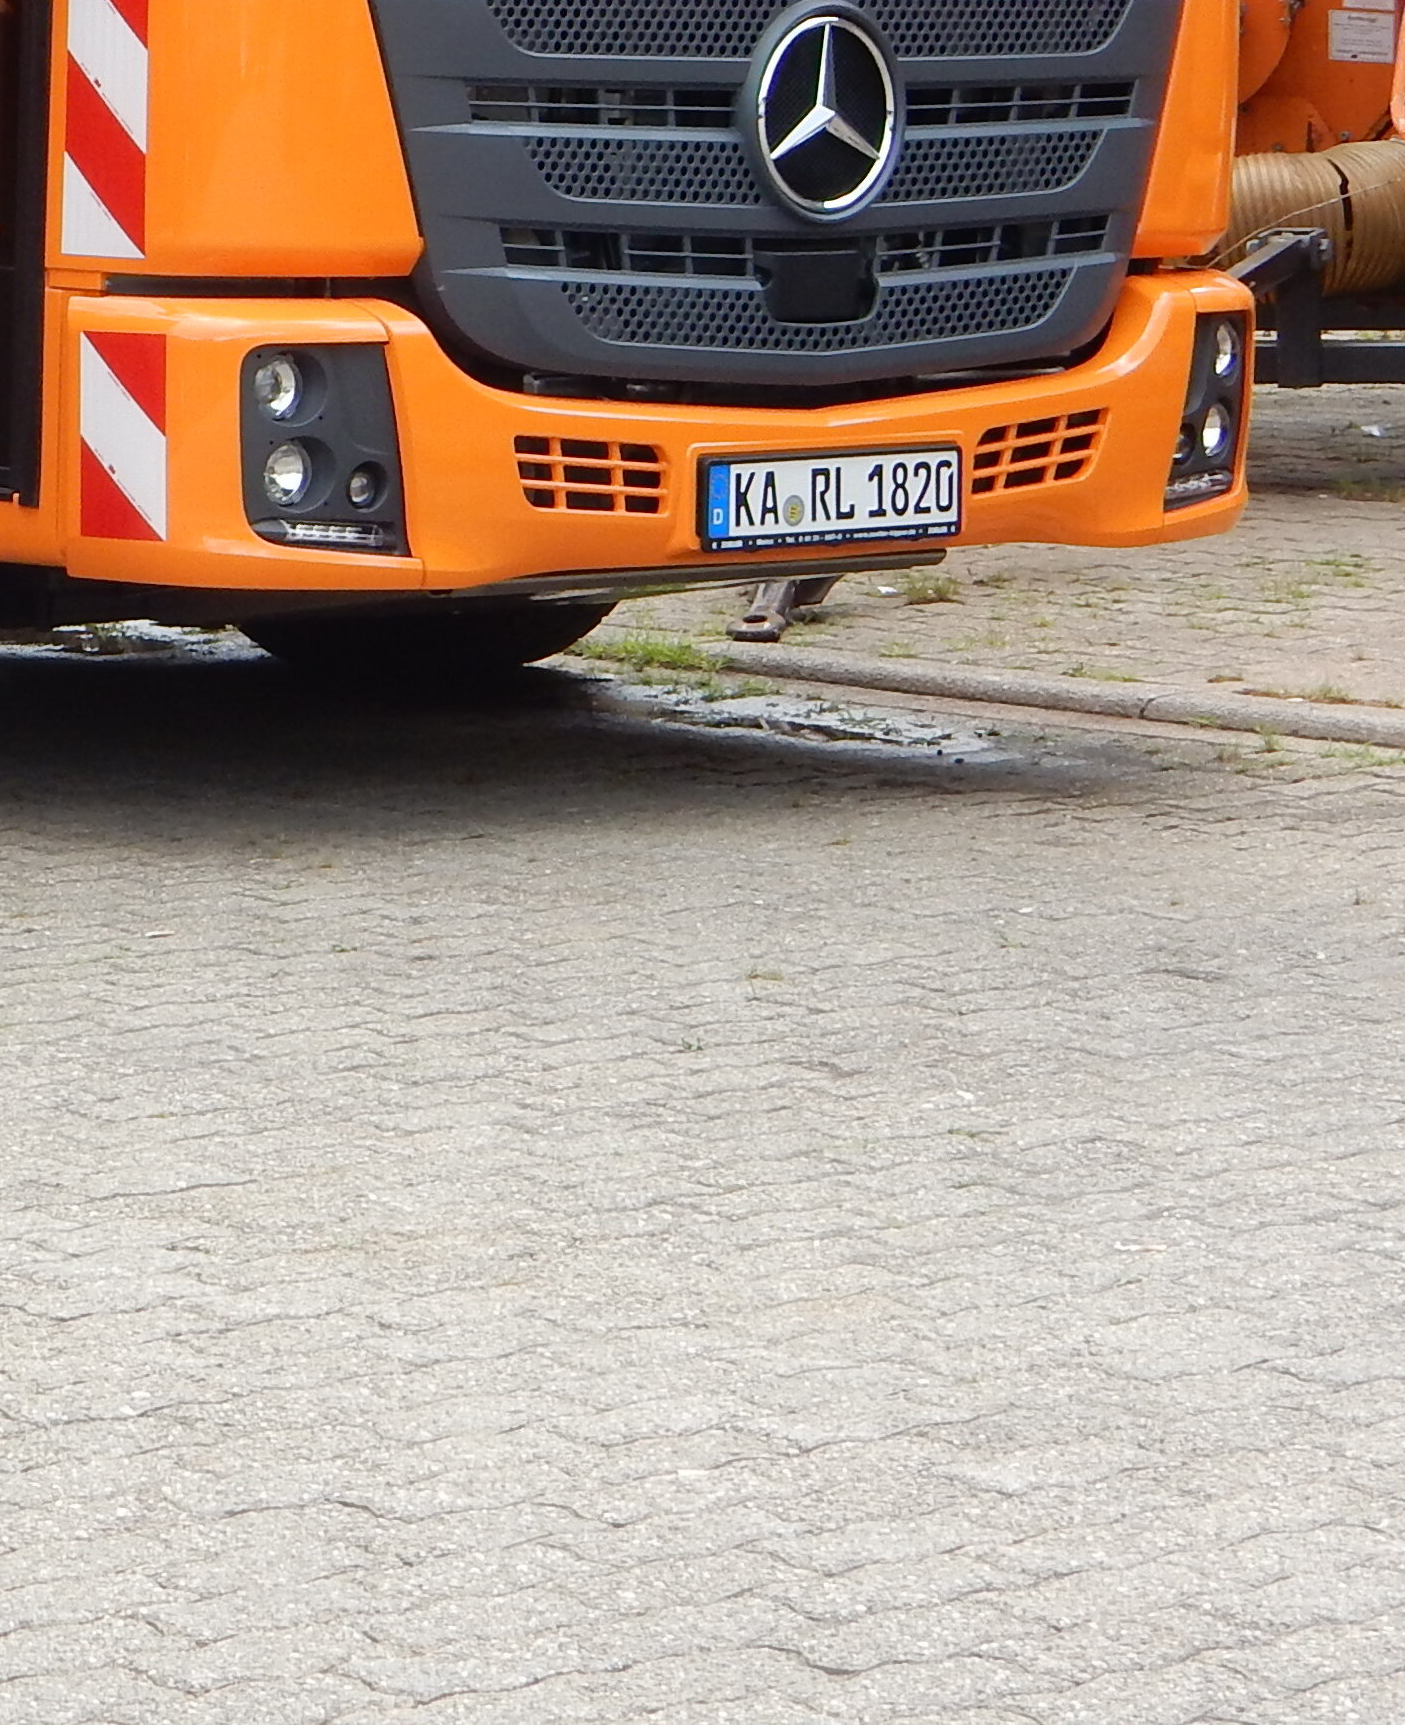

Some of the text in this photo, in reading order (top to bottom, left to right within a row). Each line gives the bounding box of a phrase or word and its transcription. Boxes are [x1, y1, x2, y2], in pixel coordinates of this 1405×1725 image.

[734, 459, 955, 527] KA RL 1820
[712, 508, 723, 525] D
